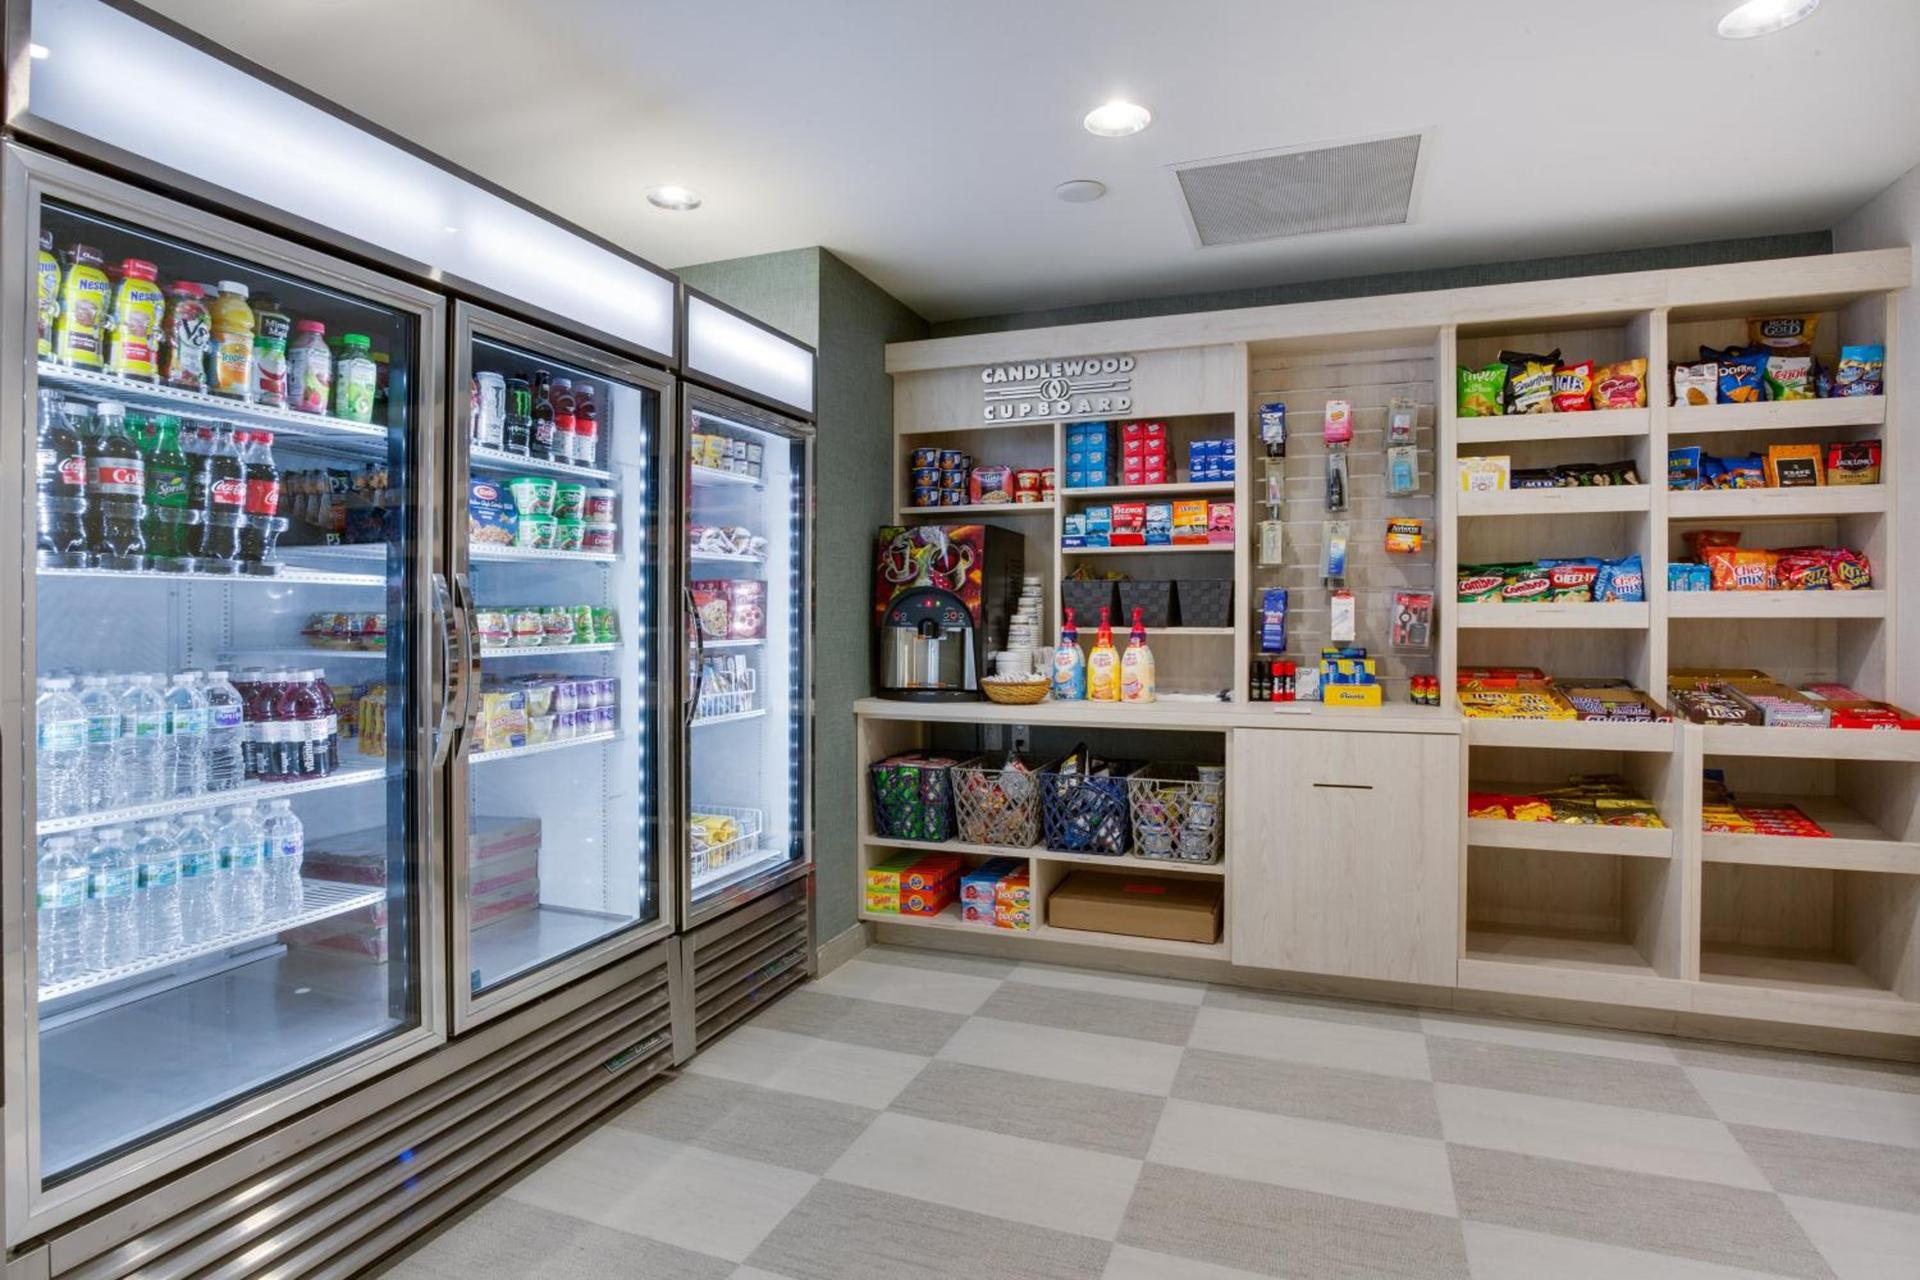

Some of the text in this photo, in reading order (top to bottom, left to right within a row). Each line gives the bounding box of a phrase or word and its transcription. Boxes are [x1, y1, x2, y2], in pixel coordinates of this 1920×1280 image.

[981, 357, 1136, 384] CANDLEWOOD
[983, 396, 1133, 419] CUPBOARD
[1113, 505, 1143, 514] TYLENOL
[1739, 575, 1763, 586] mix
